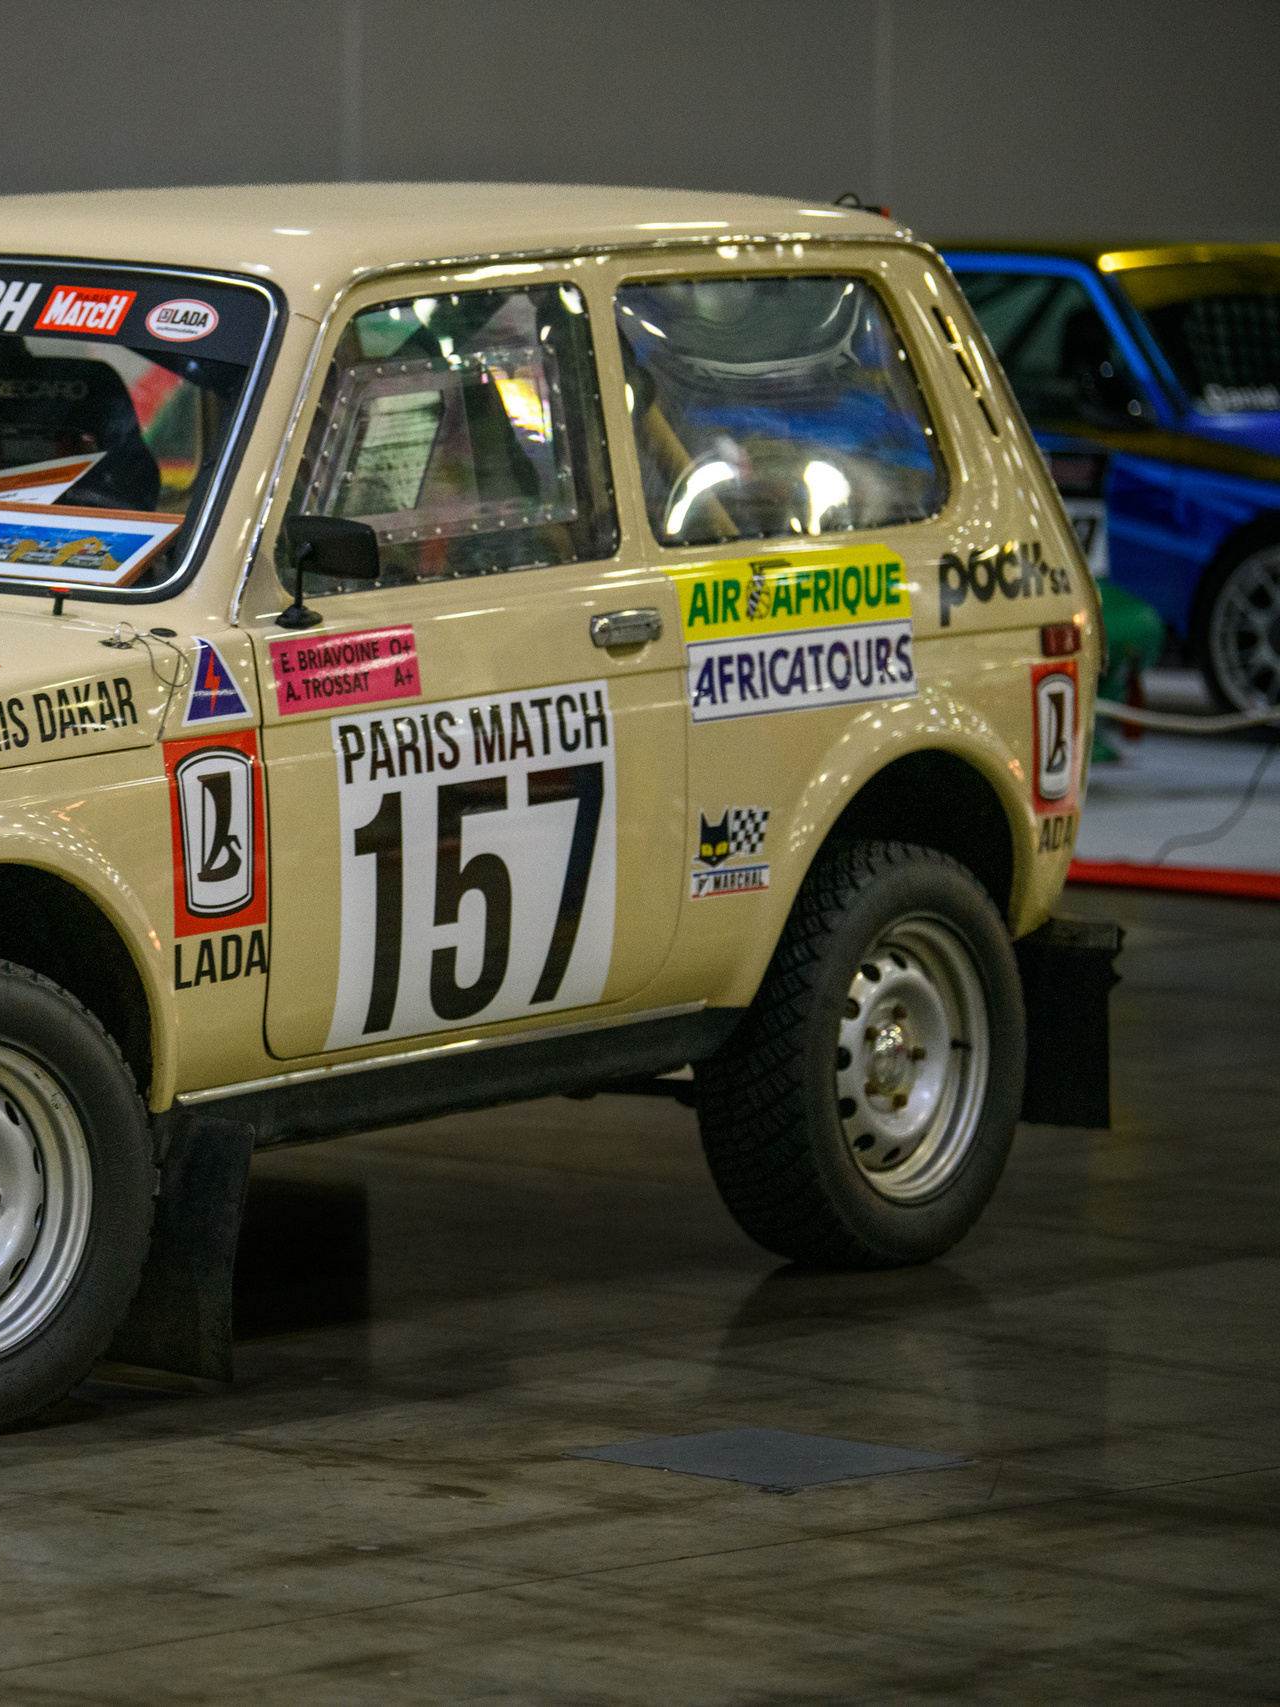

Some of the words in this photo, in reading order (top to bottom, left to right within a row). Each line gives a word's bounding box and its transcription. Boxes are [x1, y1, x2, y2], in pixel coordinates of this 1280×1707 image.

[42, 290, 129, 331] MATCH
[171, 309, 209, 328] LADA
[687, 577, 742, 627] AIR
[771, 561, 902, 618] AFRIQUE
[280, 653, 295, 674] E.
[298, 641, 380, 671] BRIAVOINE
[286, 682, 301, 703] A.
[302, 671, 372, 700] TROSSAT
[394, 667, 414, 688] A+
[691, 634, 914, 707] AFRICATOURS
[38, 677, 140, 744] DAKAR
[338, 711, 461, 785] PARIS
[468, 690, 610, 766] MATCH
[353, 761, 605, 1036] 157
[714, 870, 764, 890] MARCHAL
[174, 930, 269, 991] LADA
